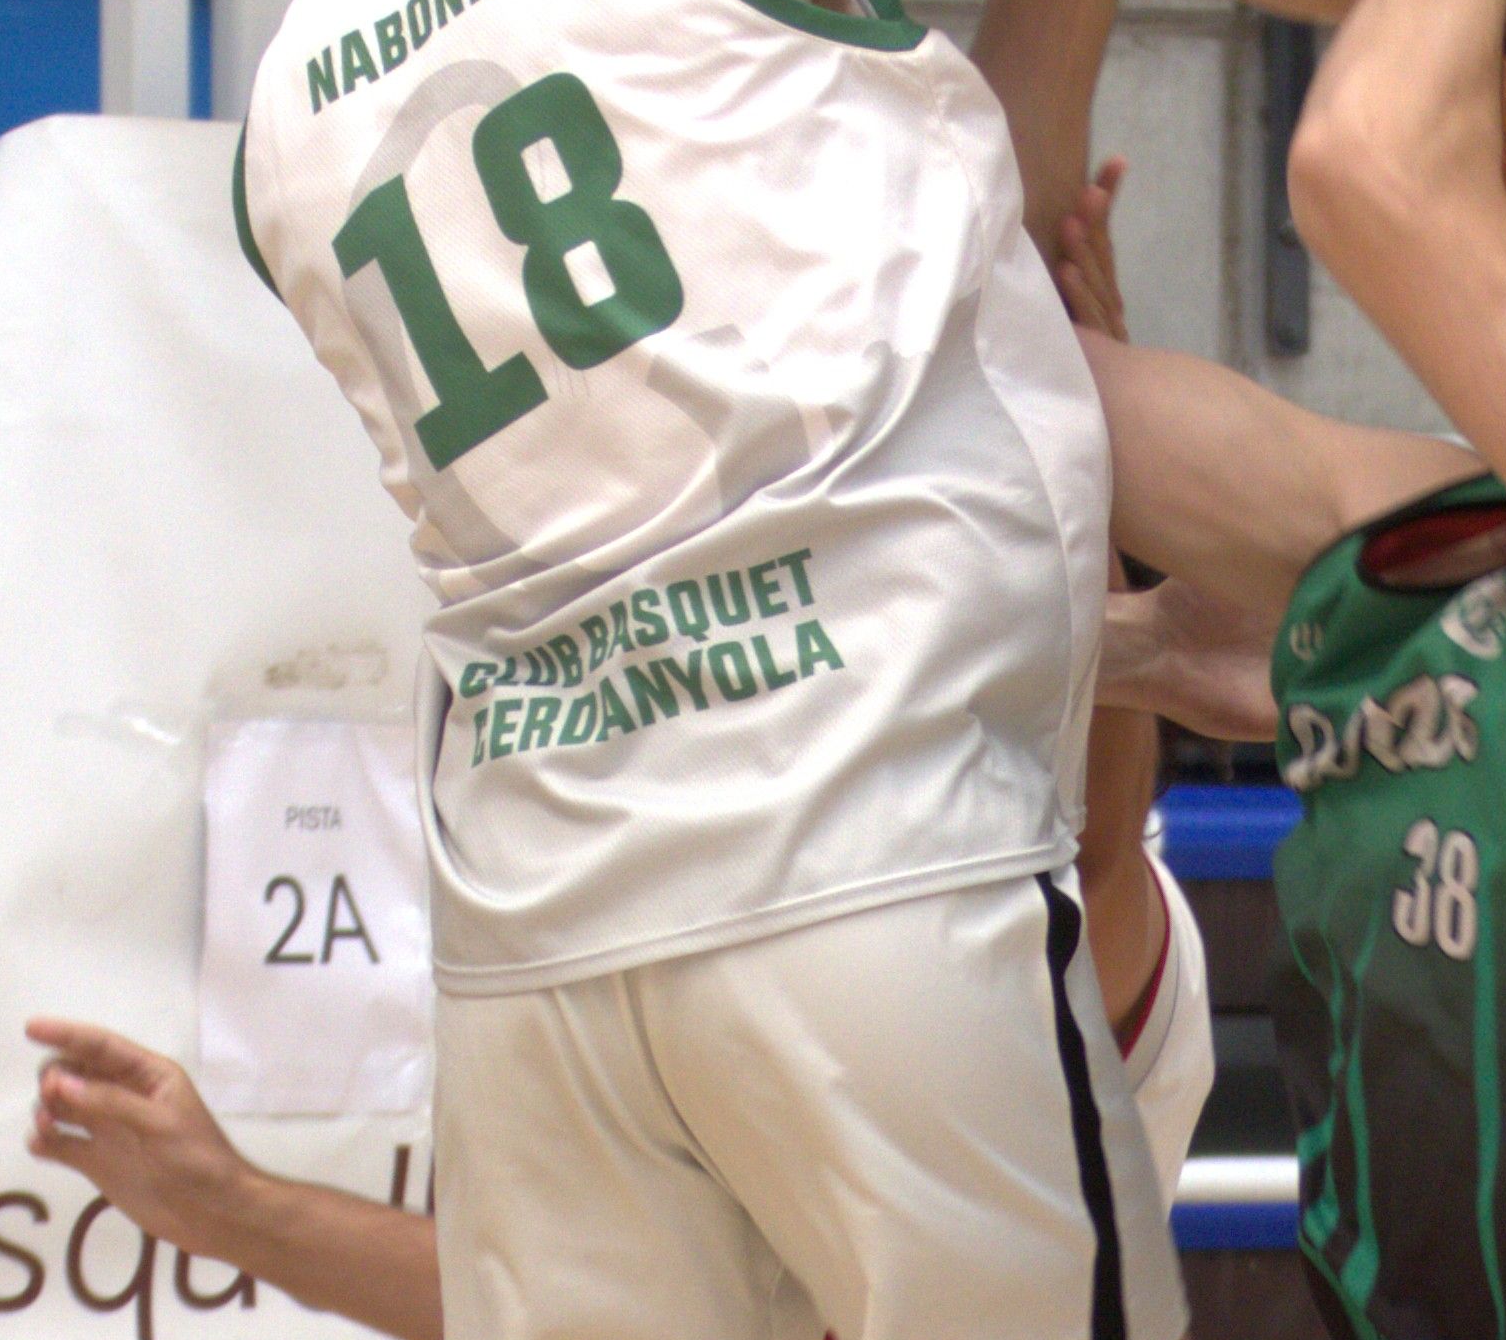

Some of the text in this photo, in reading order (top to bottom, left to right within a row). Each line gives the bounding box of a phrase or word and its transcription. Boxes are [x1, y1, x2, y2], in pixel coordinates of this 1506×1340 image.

[331, 71, 684, 472] 18
[459, 548, 814, 699] CLUB BASQUET
[284, 805, 342, 830] PISTA
[1393, 816, 1480, 961] 38
[263, 873, 381, 965] 2A
